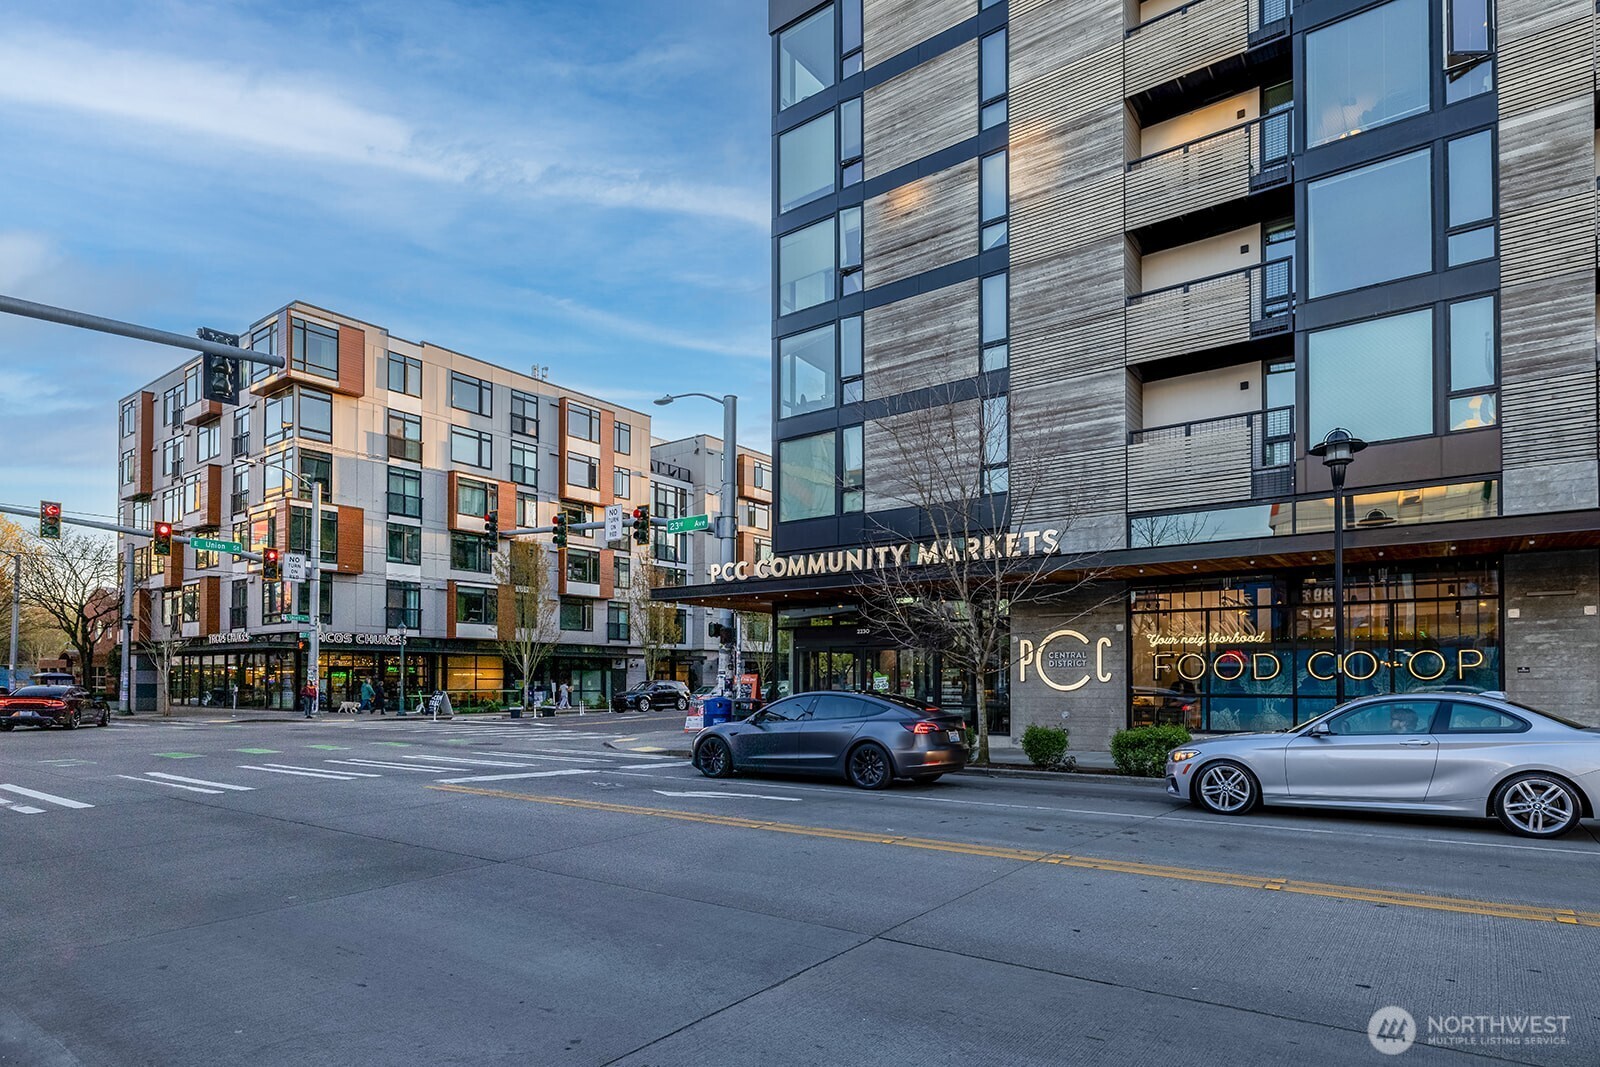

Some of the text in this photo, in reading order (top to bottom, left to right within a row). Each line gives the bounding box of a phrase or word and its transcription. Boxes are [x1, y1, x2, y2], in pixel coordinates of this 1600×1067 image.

[669, 519, 705, 531] 23rd Ave
[205, 541, 226, 550] Union
[710, 530, 1060, 584] PCC COMMUNITY MARKETS
[318, 632, 353, 644] ACOS
[355, 633, 407, 646] CHUKIS
[1147, 631, 1265, 647] Your neighborhood
[1019, 629, 1112, 692] PCC
[1048, 651, 1087, 659] CENTRAL
[1048, 660, 1087, 668] DISTRICT
[1154, 652, 1280, 681] FOOD
